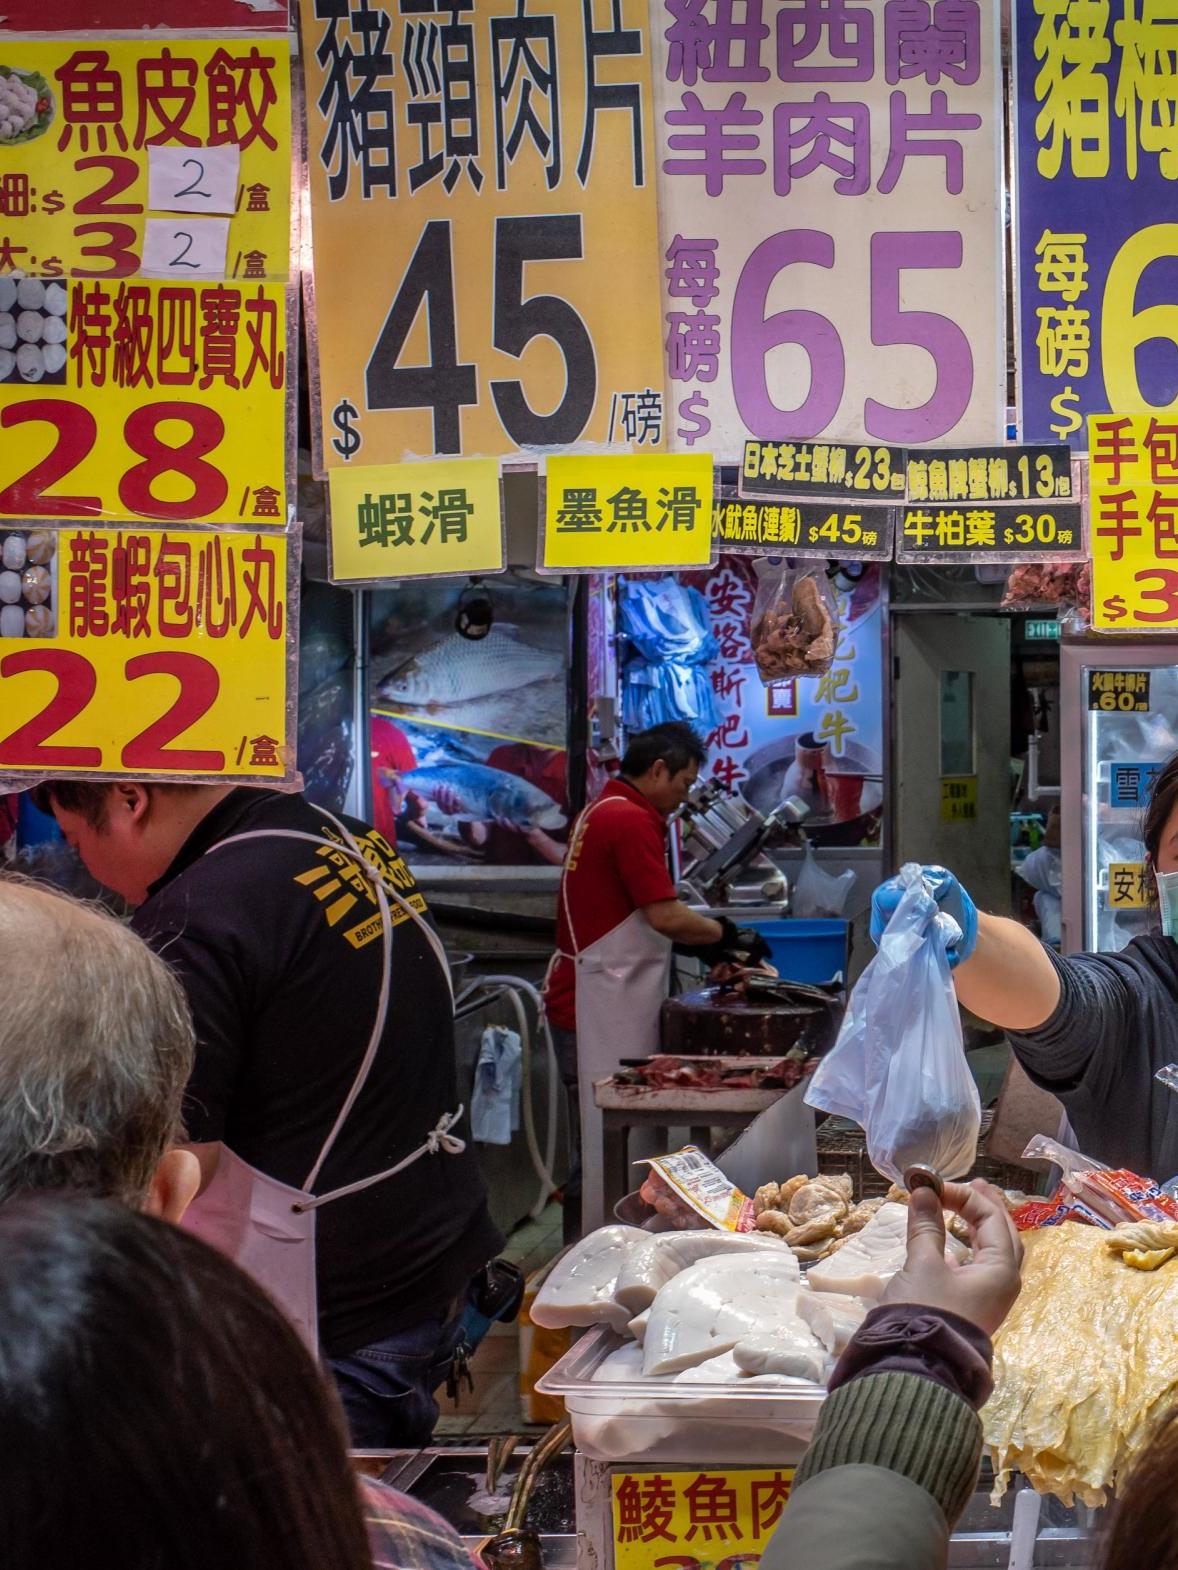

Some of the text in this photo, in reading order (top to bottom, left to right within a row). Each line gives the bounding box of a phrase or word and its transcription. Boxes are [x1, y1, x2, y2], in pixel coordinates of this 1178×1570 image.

[54, 46, 278, 152] 魚皮餃
[663, 91, 982, 197] 羊肉片
[69, 281, 285, 391] 特級四寶丸
[356, 488, 474, 548] 蝦滑
[556, 485, 704, 536] 墨魚滑
[903, 511, 996, 546] 牛柏葉
[69, 530, 283, 640] 龍蝦包心丸
